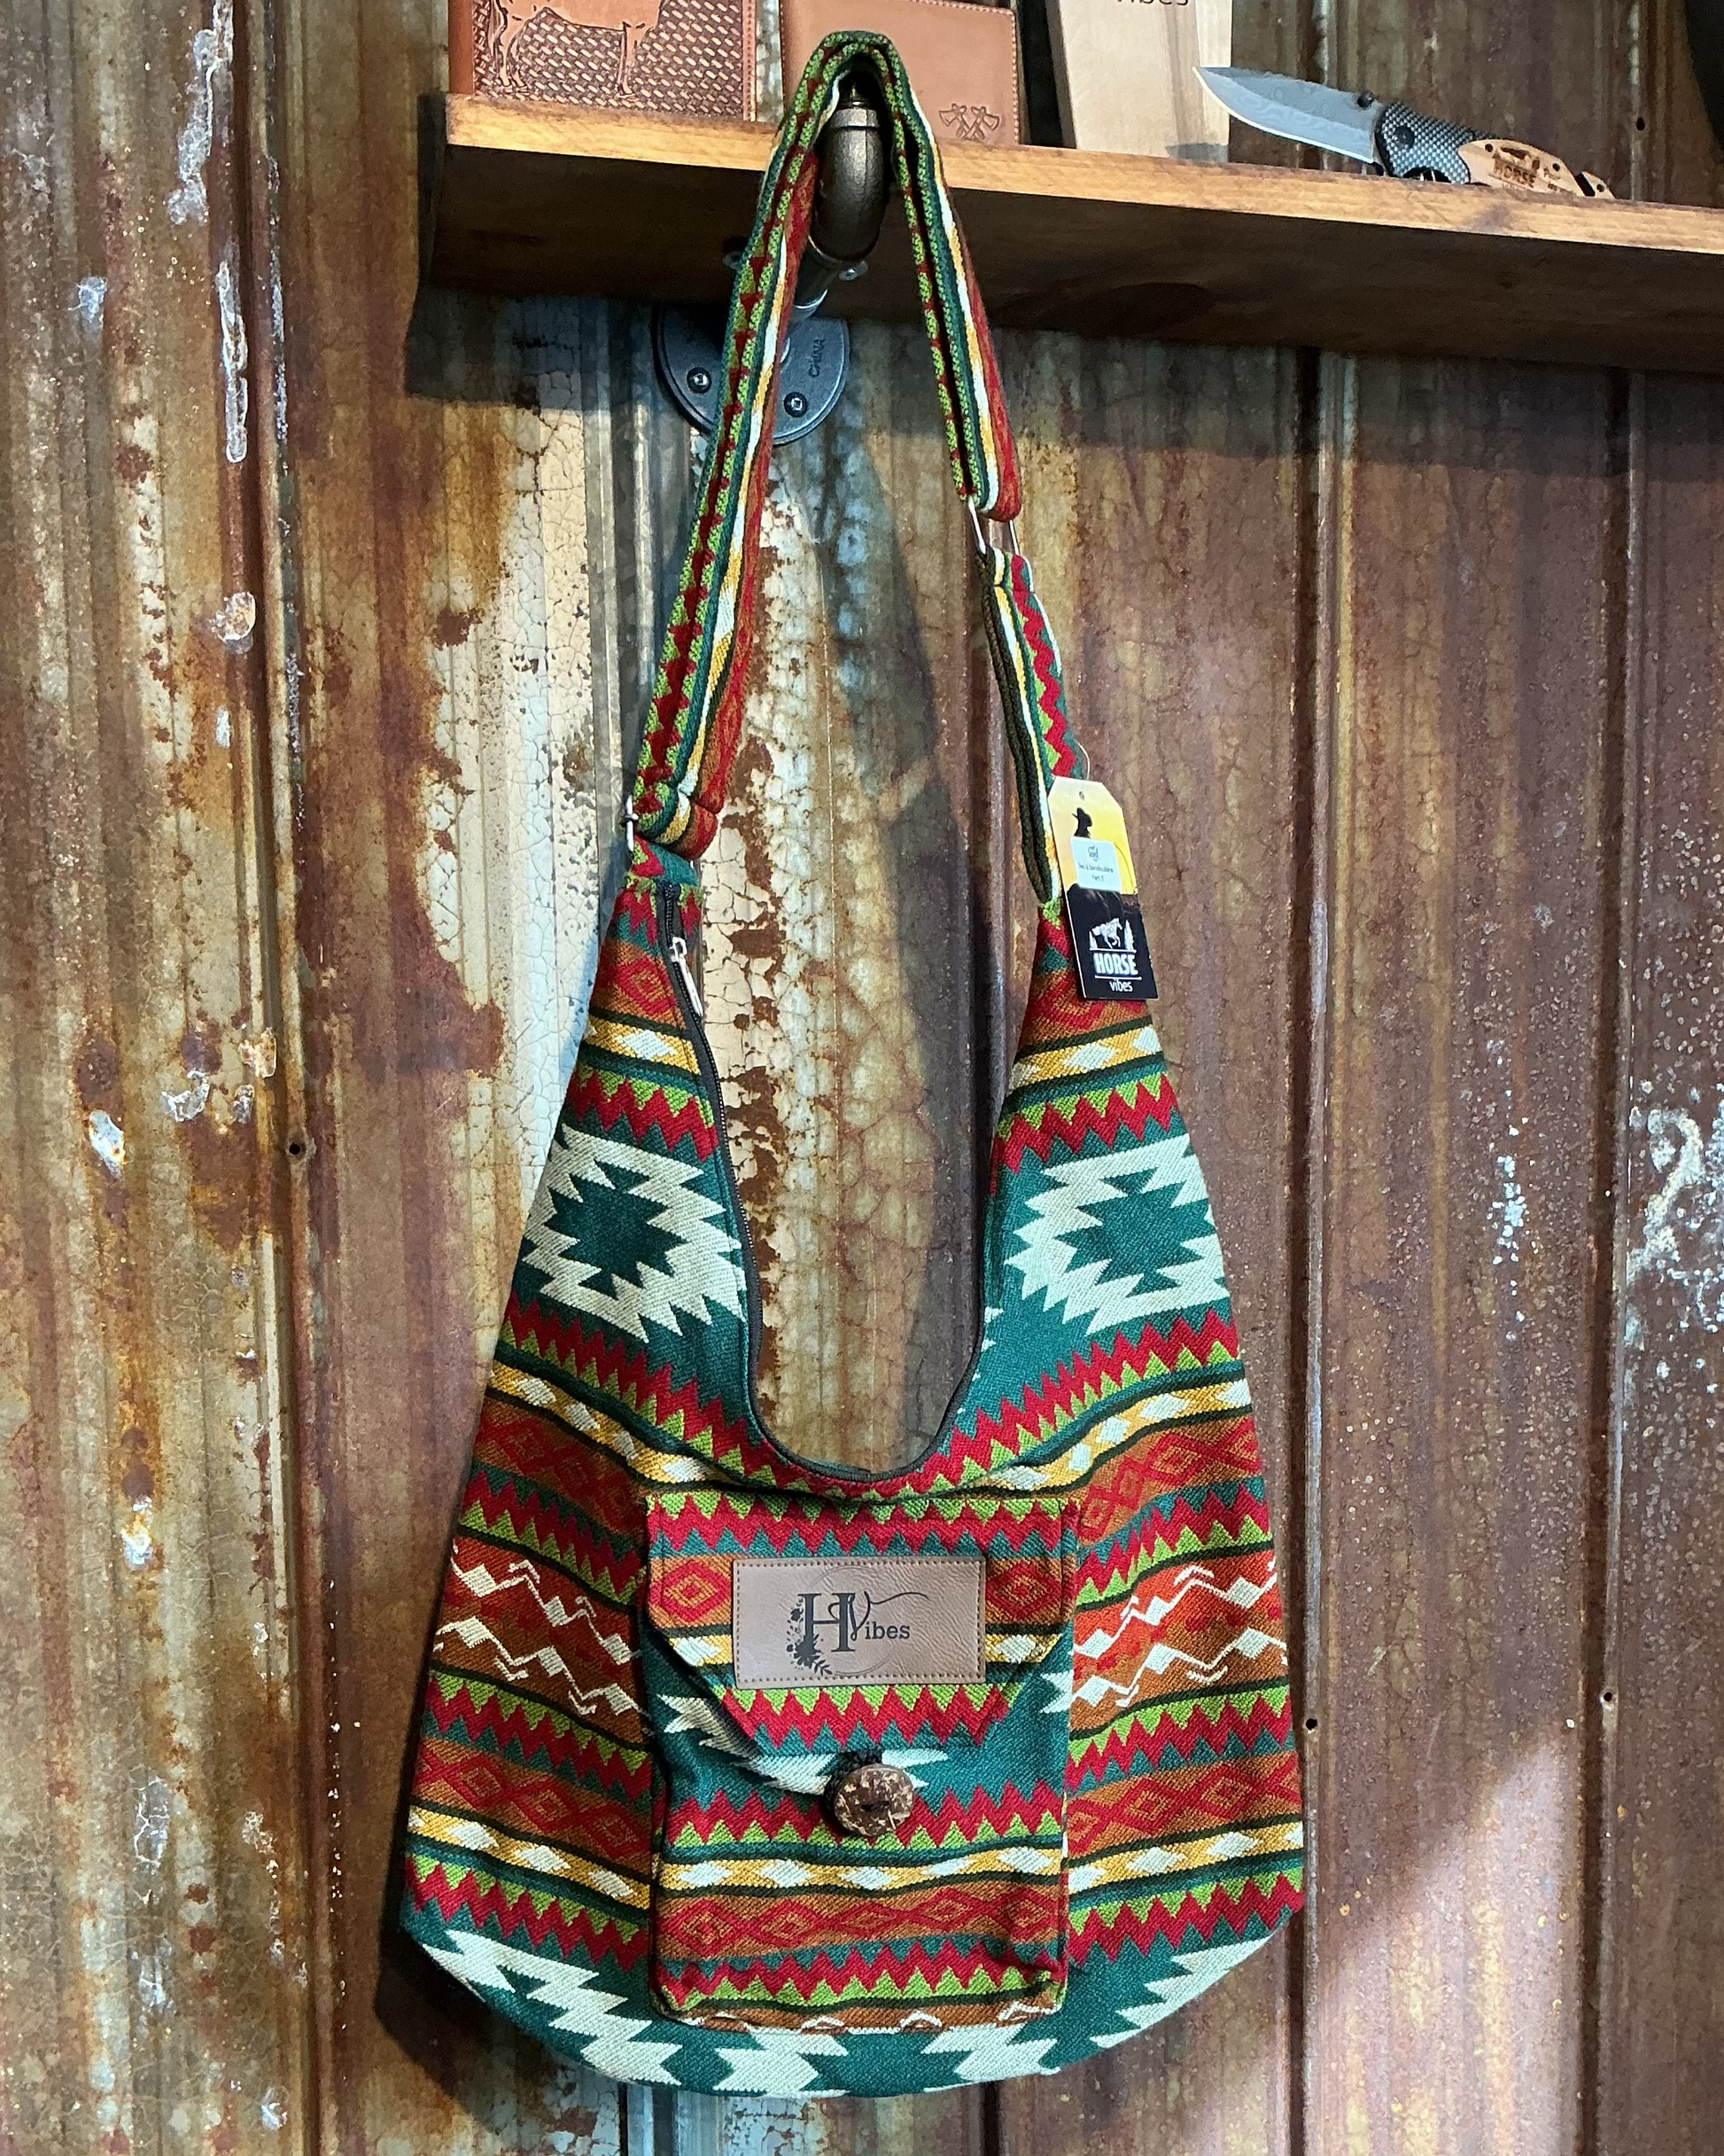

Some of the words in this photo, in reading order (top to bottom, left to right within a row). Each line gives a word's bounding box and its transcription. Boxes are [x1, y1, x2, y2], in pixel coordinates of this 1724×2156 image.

[1493, 158, 1536, 188] HORSE
[808, 337, 826, 378] CHINA
[1093, 953, 1138, 976] HORSE
[1109, 978, 1133, 992] vibes
